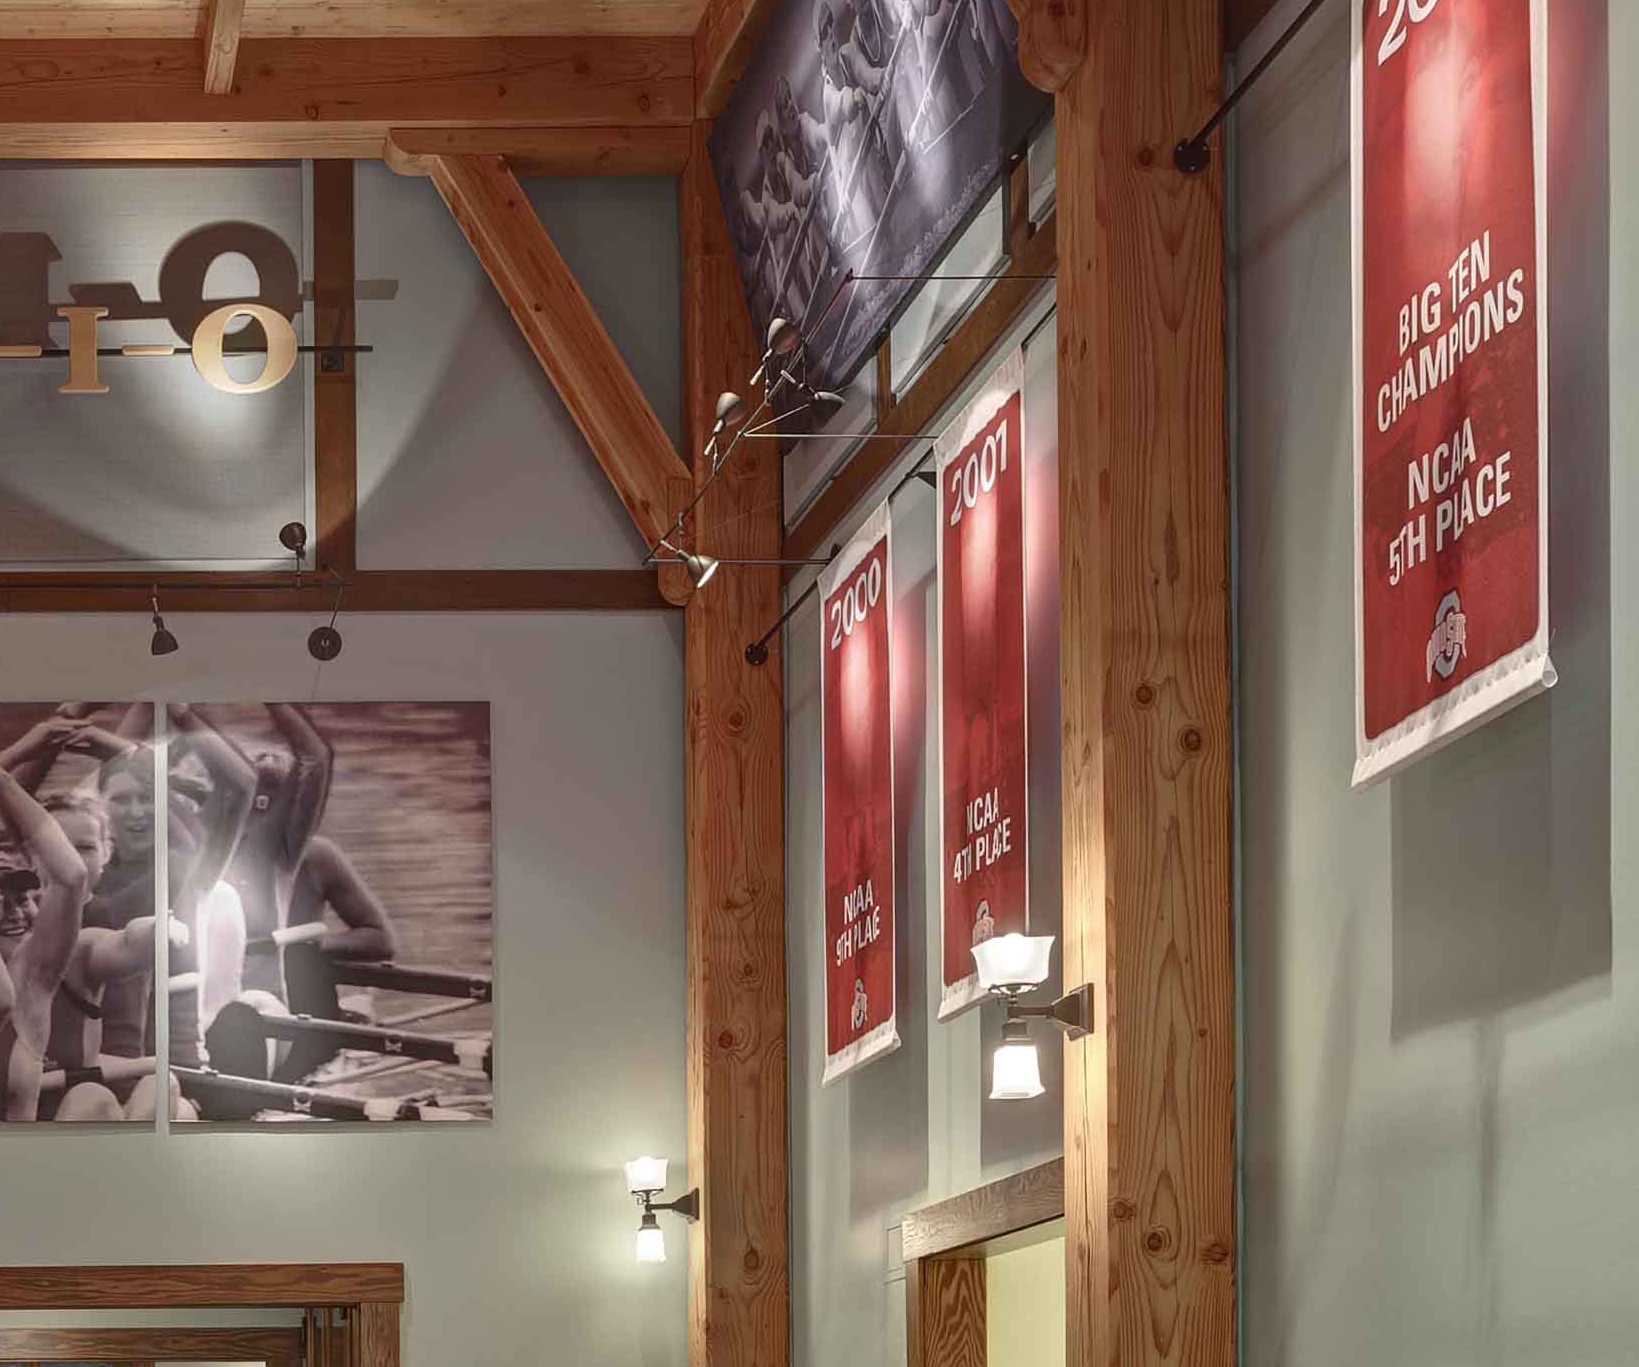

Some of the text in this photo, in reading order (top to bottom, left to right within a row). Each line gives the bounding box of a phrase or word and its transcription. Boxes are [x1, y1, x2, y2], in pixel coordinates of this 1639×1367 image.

[1377, 268, 1525, 434] CHAMPIONS
[1398, 231, 1491, 357] BIG TEN
[950, 418, 1008, 527] 2001
[1388, 451, 1512, 587] 5TH PLACE
[1408, 417, 1477, 510] NCAA
[830, 557, 882, 651] 2000
